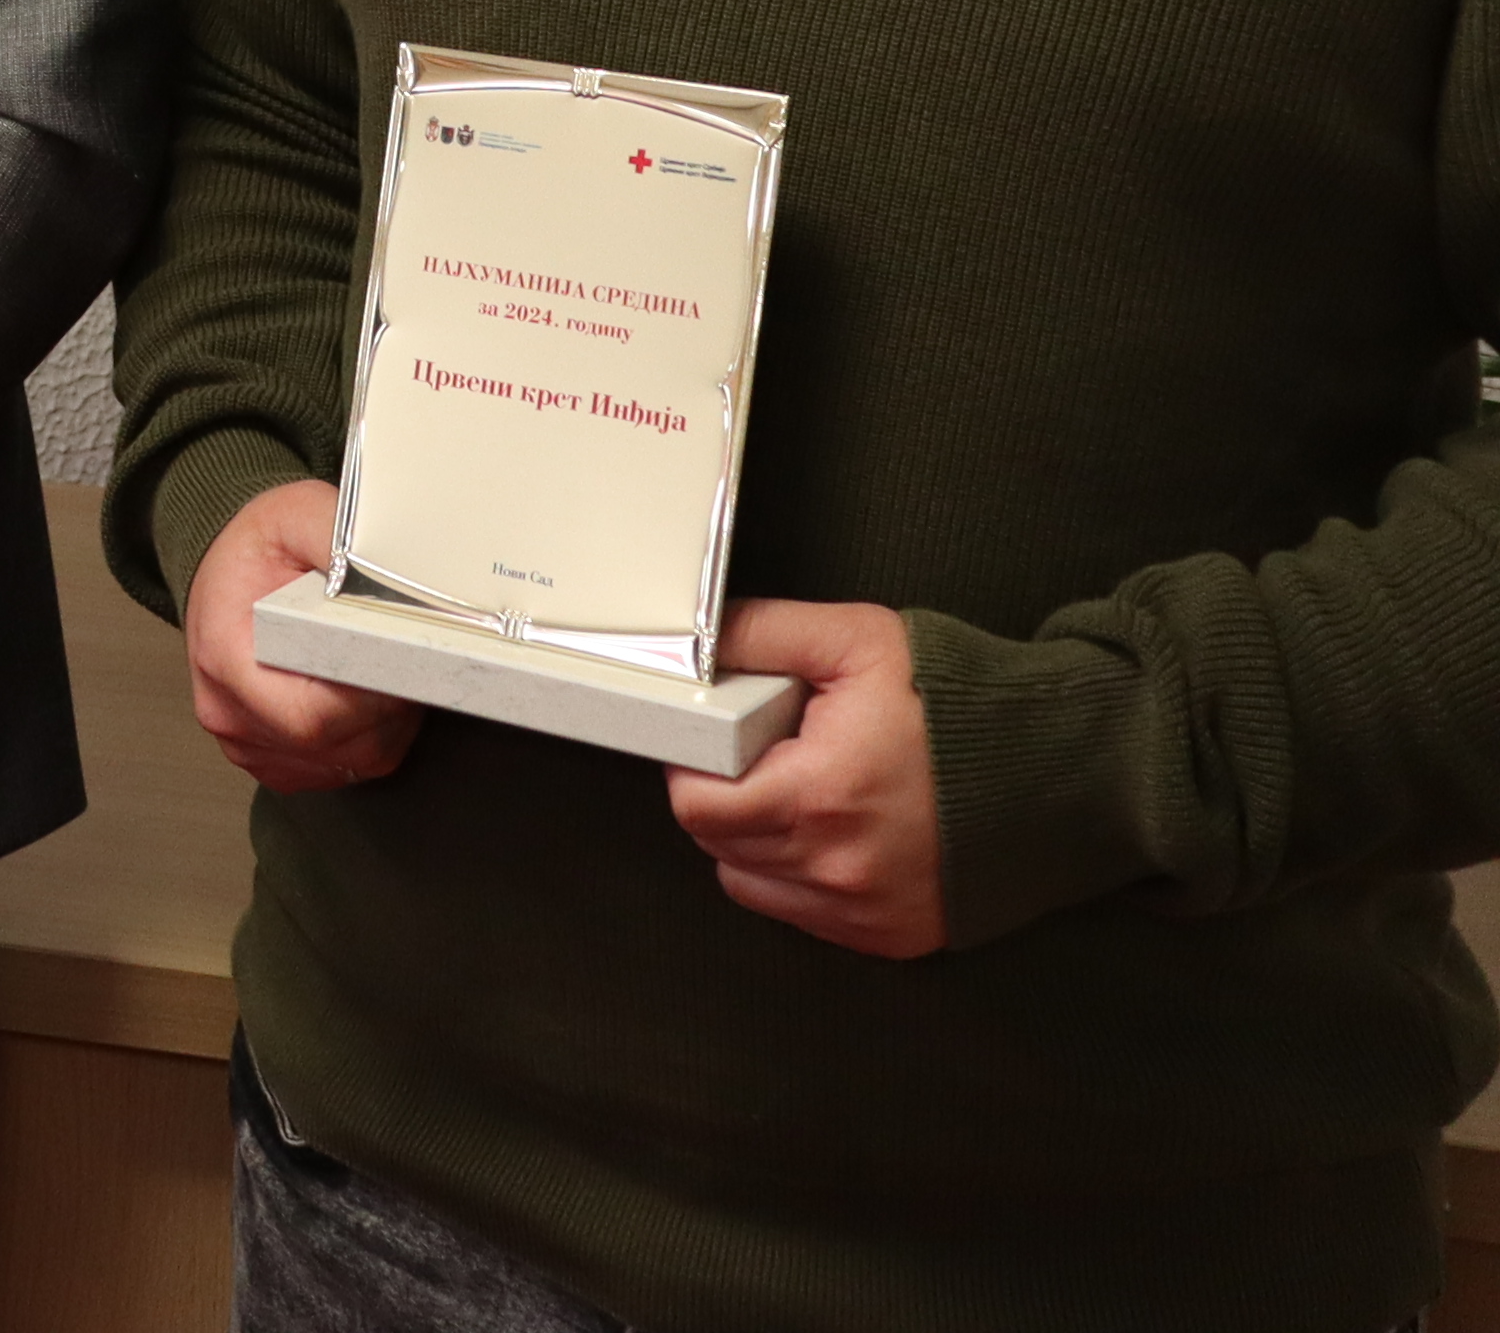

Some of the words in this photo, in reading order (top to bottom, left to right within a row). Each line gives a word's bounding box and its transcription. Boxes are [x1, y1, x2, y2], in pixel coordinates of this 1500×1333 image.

[423, 255, 586, 300] НАЈХУМАНИЈА
[591, 285, 700, 320] СРЕДИНА
[478, 303, 499, 317] за
[504, 302, 559, 328] 2024.
[566, 318, 633, 345] годину
[413, 358, 513, 399] Црвени
[520, 385, 582, 411] крст
[590, 392, 687, 434] Инђија
[491, 561, 527, 581] Нови
[529, 570, 554, 588] Сад
